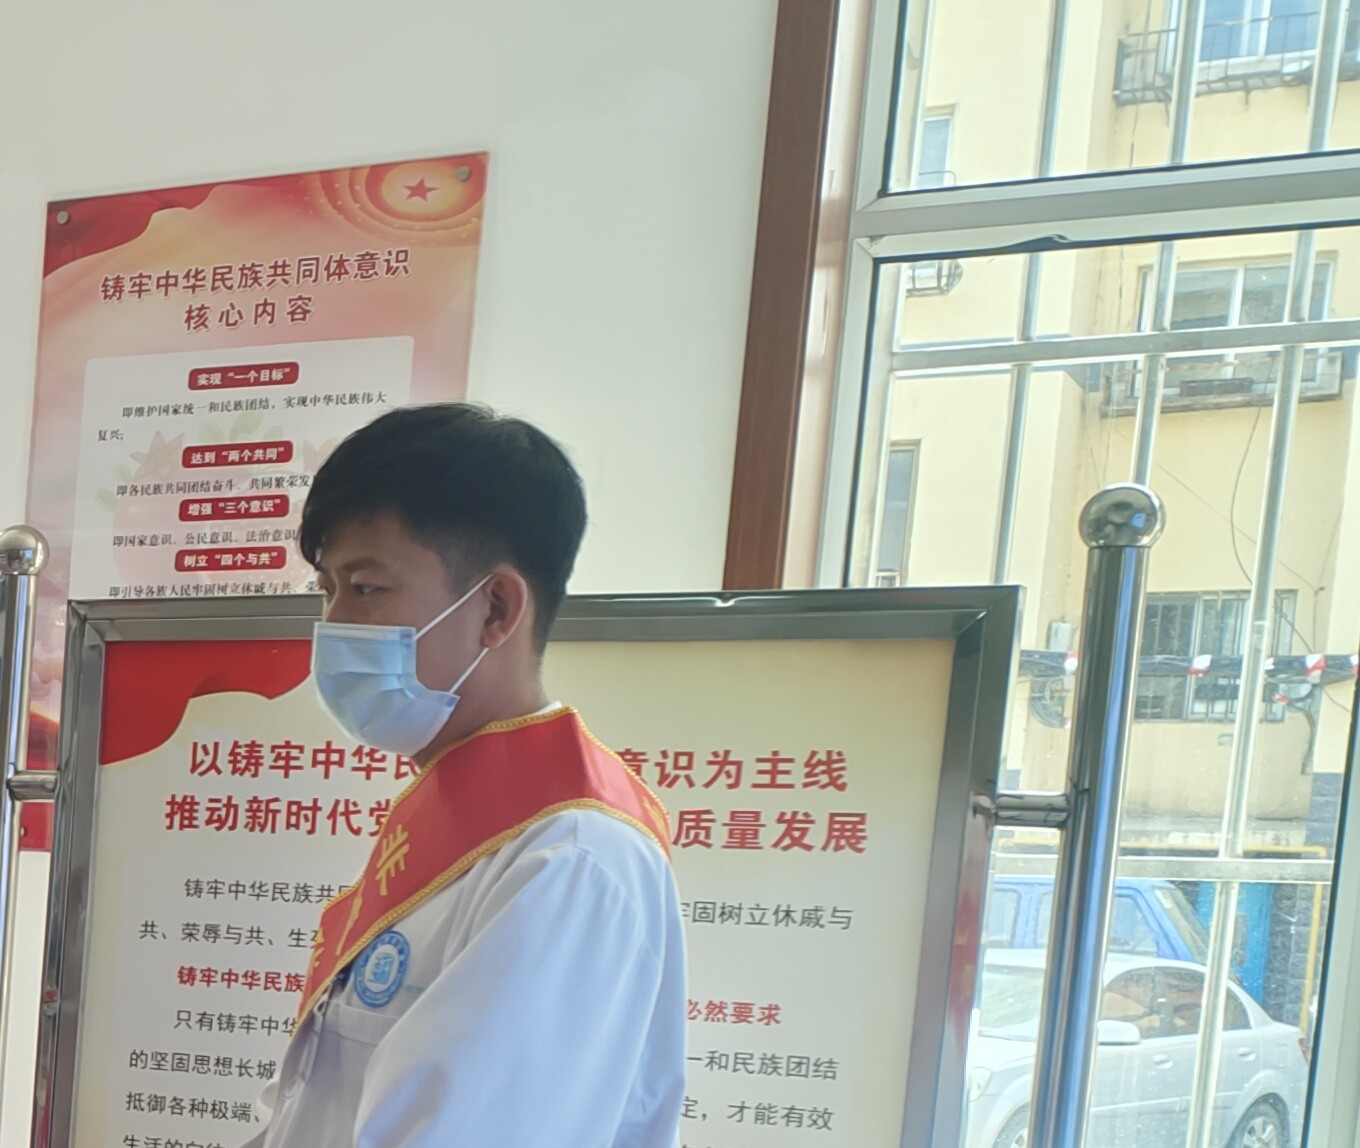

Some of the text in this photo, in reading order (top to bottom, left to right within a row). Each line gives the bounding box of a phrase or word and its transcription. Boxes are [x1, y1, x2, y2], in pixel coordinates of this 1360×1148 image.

[100, 248, 411, 302] 铸牢中华民族共同体意识
[184, 294, 313, 331] 核心内容
[116, 475, 316, 497] 即各民族共同团结奋斗、共同繁荣发
[671, 809, 869, 854] 质量发展
[375, 824, 410, 896] 非
[686, 999, 782, 1026] 必然要求
[128, 1048, 278, 1081] 的坚固思想长城
